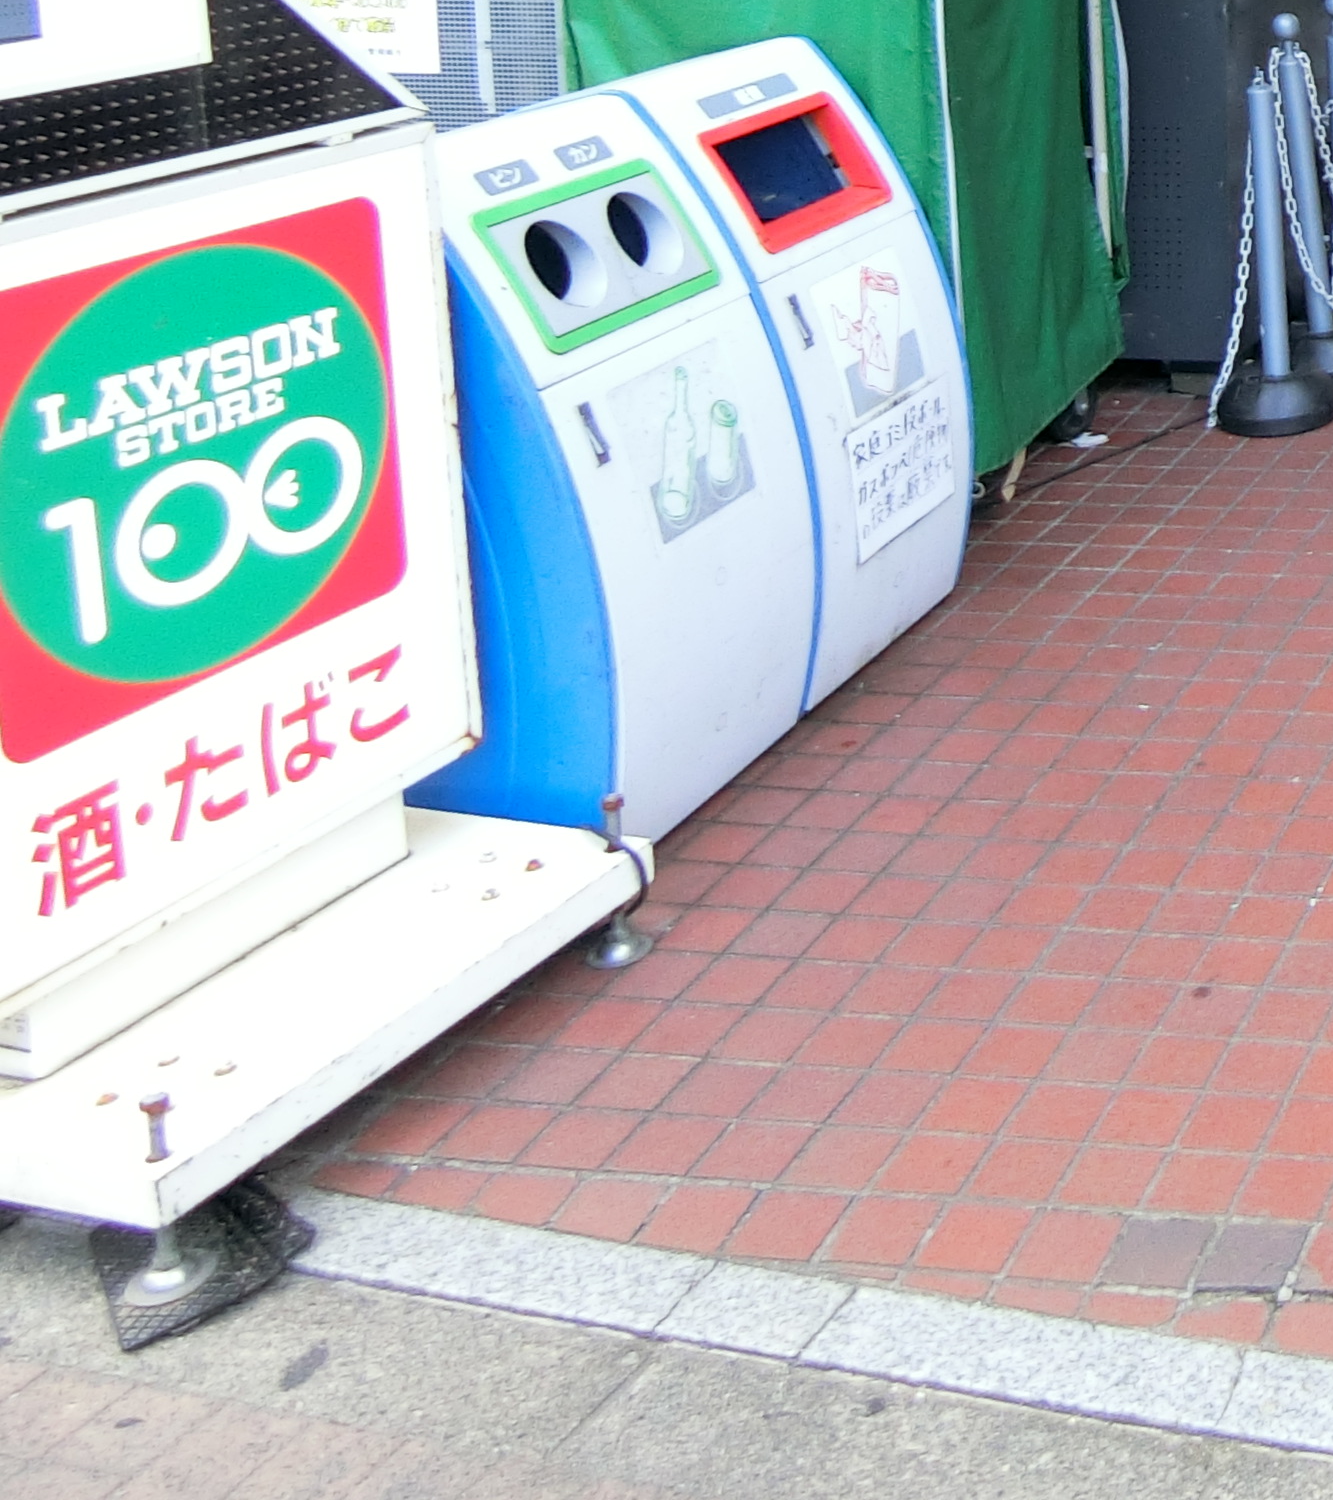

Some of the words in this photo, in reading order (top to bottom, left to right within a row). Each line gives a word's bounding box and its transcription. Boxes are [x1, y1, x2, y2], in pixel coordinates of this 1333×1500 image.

[487, 165, 524, 190] ビン
[567, 143, 600, 165] カン
[34, 305, 342, 455] LAWSON
[114, 375, 288, 470] STORE
[42, 414, 365, 646] 100
[29, 643, 411, 918] 酒・たばこ
